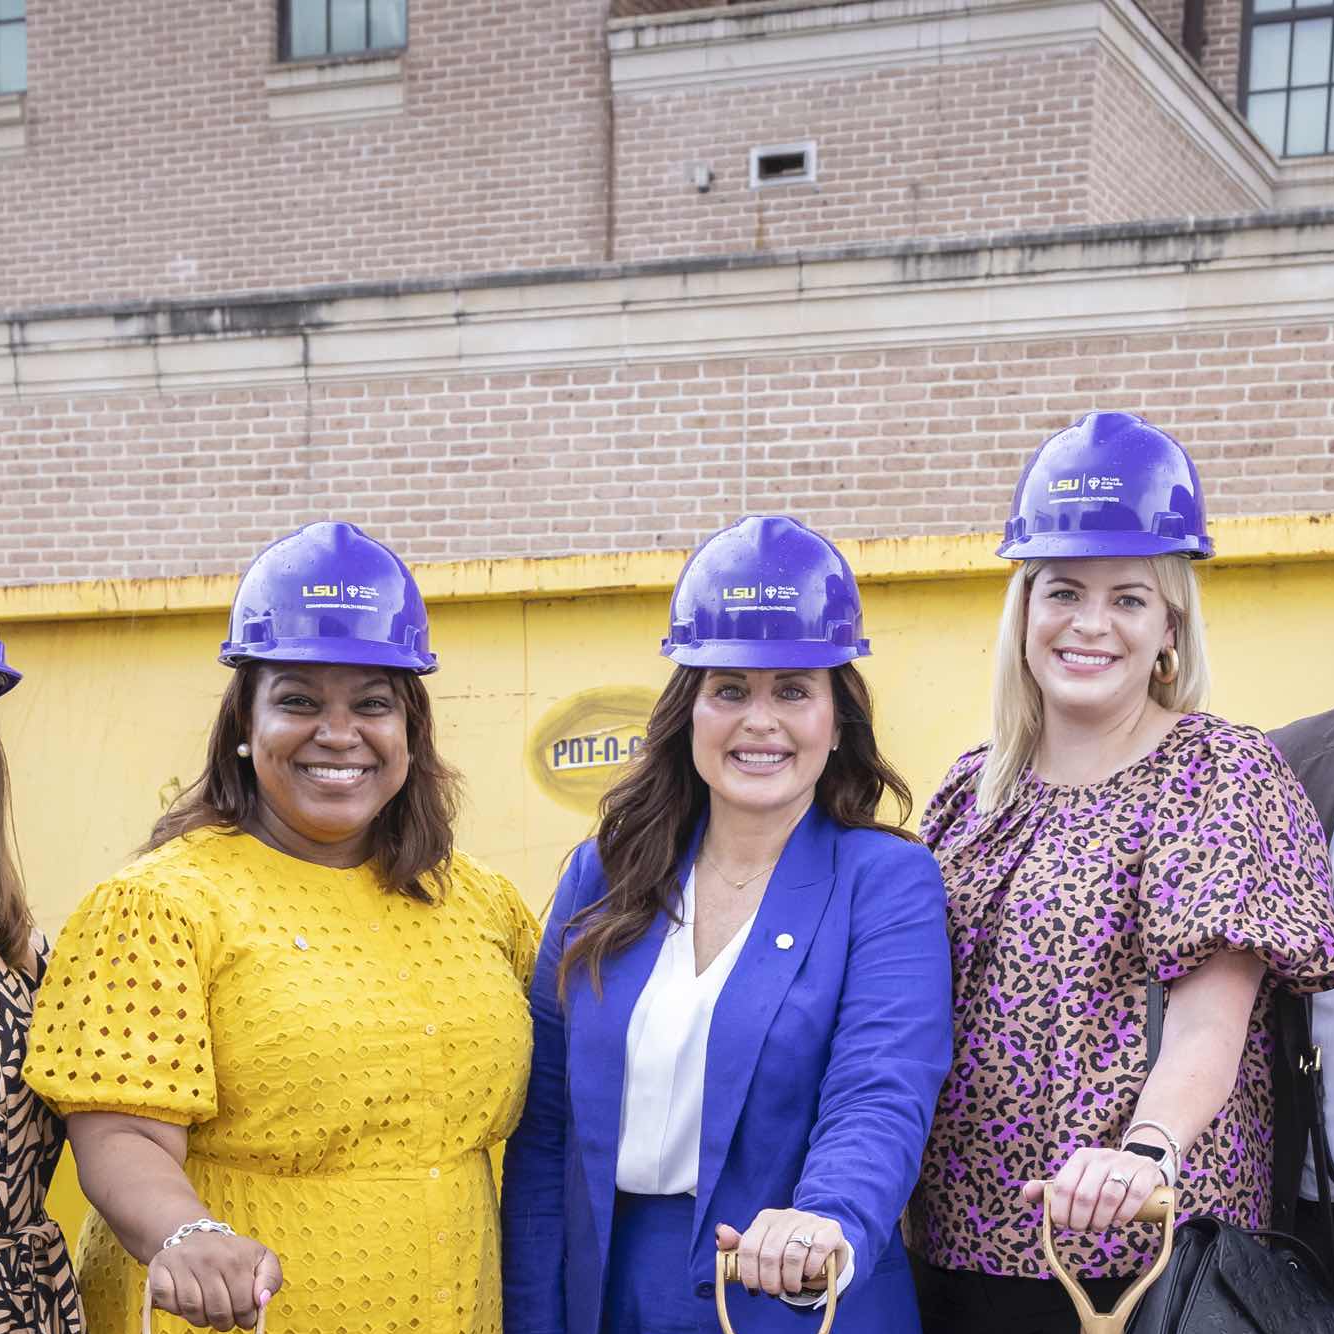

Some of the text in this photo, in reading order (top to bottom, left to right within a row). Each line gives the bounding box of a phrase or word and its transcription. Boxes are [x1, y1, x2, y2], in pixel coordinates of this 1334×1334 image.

[1048, 479, 1079, 492] LSU
[302, 585, 338, 597] LSU
[723, 587, 756, 600] LSU
